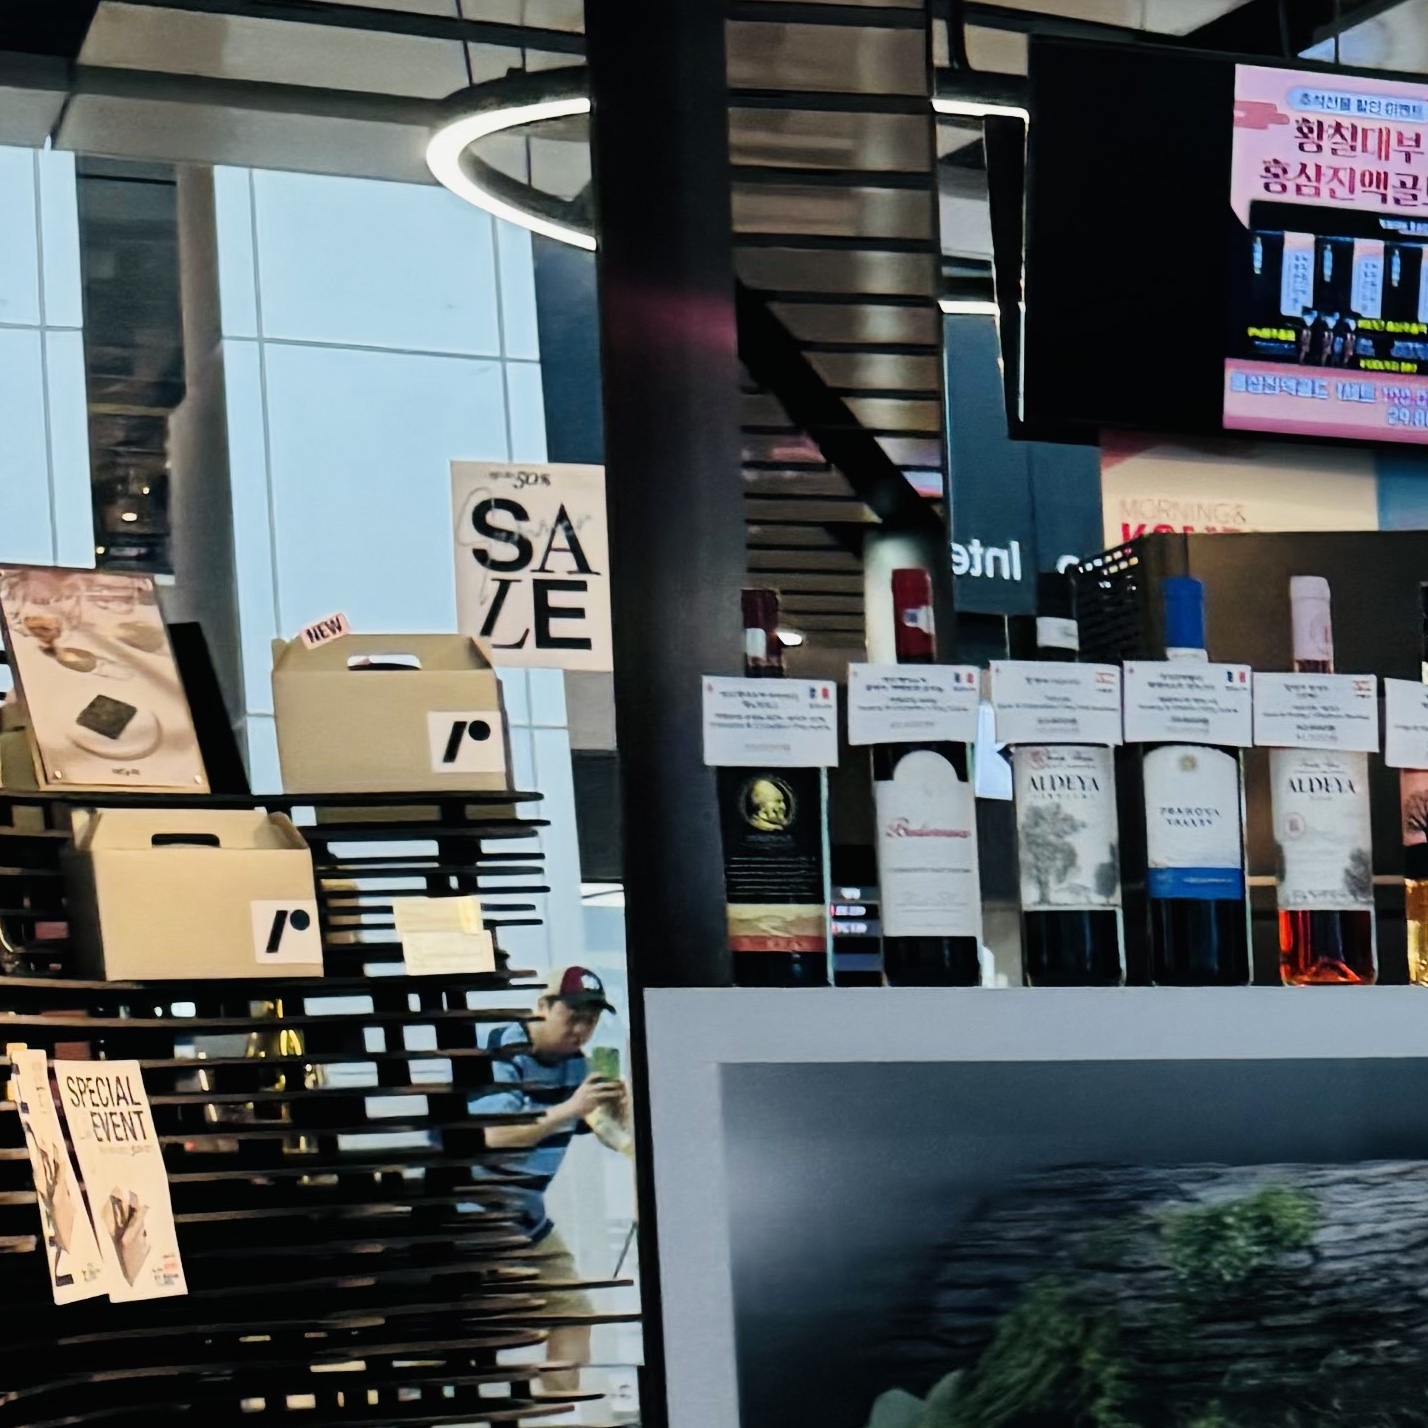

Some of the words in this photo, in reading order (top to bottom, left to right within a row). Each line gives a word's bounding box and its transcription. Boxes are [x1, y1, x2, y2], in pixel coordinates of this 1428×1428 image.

[1294, 117, 1425, 165] 황칠대부
[305, 616, 345, 643] NEW
[66, 1075, 142, 1109] SPECIAL
[89, 1110, 148, 1143] EVENT
